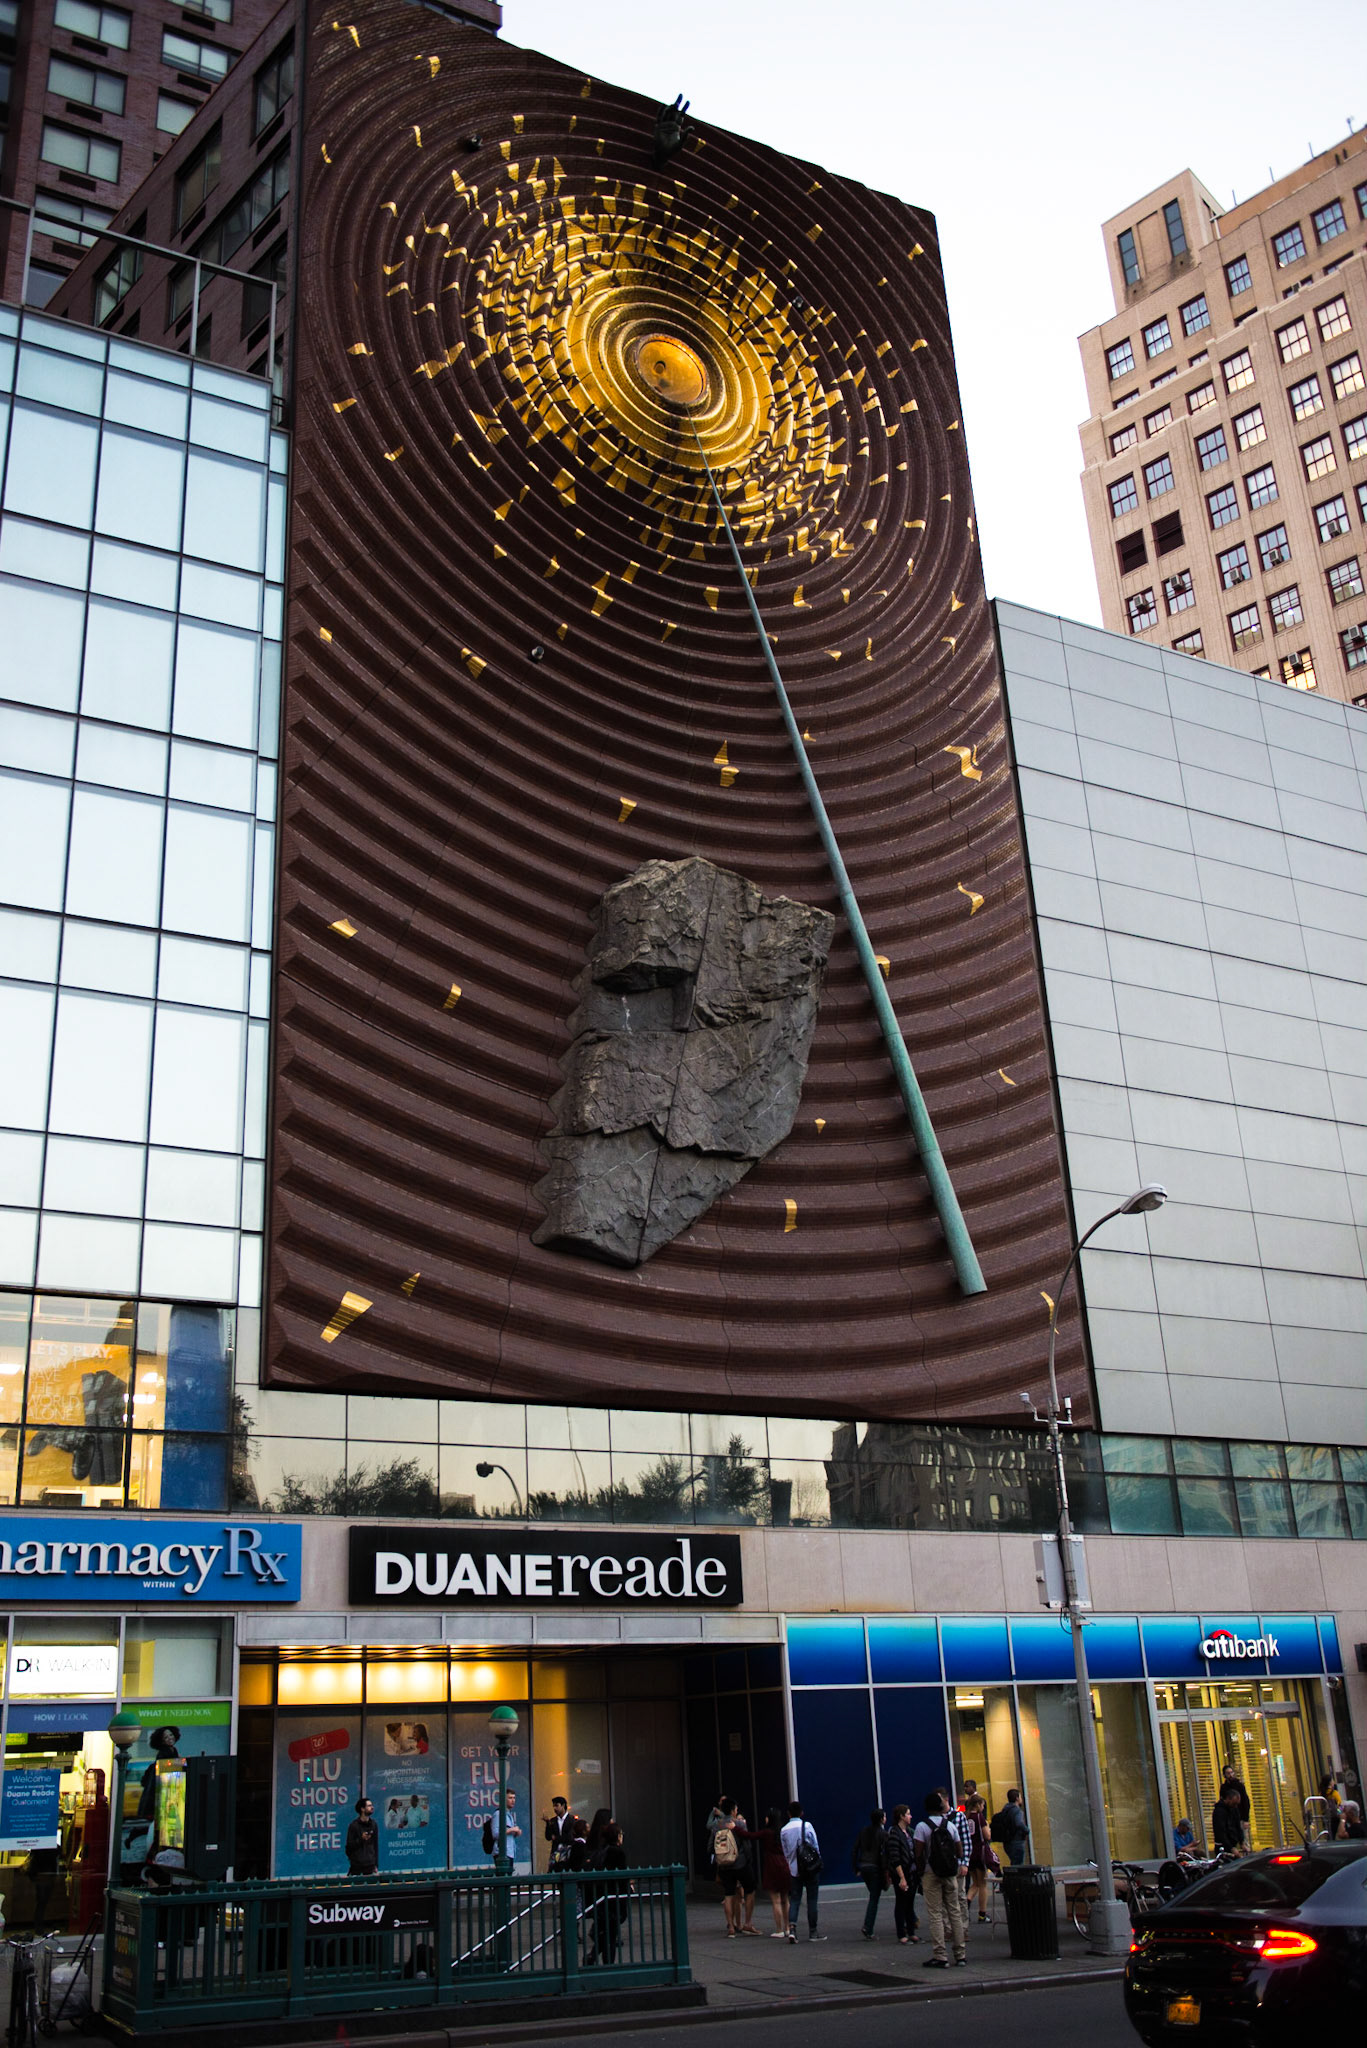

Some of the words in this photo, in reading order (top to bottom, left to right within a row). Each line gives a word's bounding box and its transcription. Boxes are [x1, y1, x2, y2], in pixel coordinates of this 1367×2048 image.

[143, 1580, 175, 1588] WITHIN
[1202, 1633, 1280, 1658] citibank
[63, 1713, 88, 1721] LOOK
[139, 1709, 162, 1717] WHAT
[169, 1709, 193, 1717] NEED
[194, 1708, 212, 1716] NOW
[460, 1746, 482, 1758] GET
[488, 1745, 520, 1757] YR
[299, 1758, 341, 1783] FLU
[12, 1775, 51, 1783] Welcome
[6, 1790, 30, 1798] Duane
[32, 1789, 55, 1797] Reade
[291, 1786, 348, 1806] SHOTS
[303, 1811, 337, 1829] ARE
[296, 1832, 341, 1850] HERE
[388, 1840, 426, 1848] INSURANCE
[308, 1903, 386, 1924] Subway
